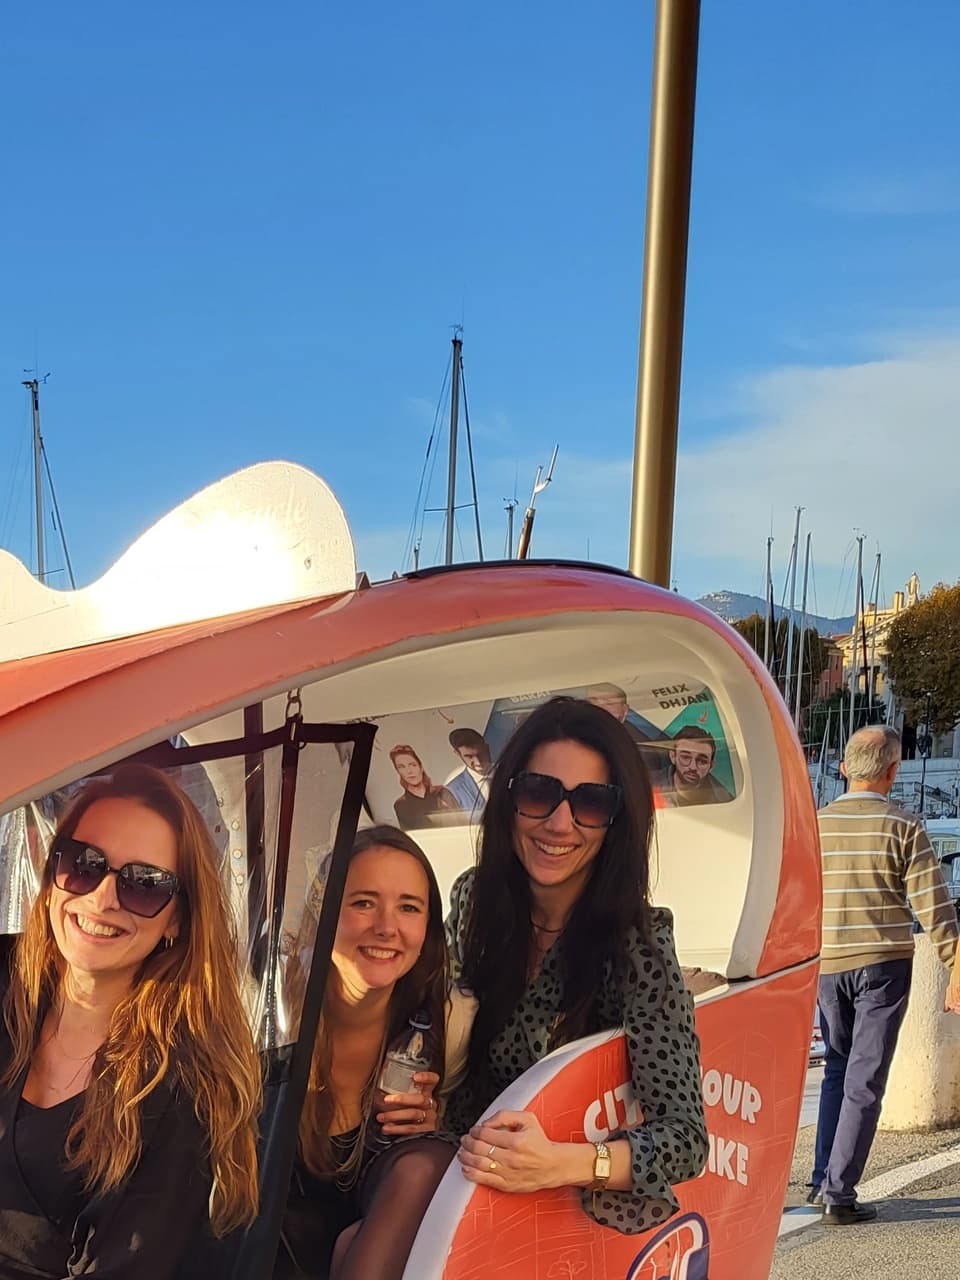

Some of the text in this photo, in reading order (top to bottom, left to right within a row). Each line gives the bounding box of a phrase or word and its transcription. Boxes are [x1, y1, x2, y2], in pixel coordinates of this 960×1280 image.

[651, 683, 690, 698] FELIX
[659, 692, 709, 709] DHJAN
[583, 1066, 762, 1143] CIT OUR
[697, 1133, 749, 1186] IKE
